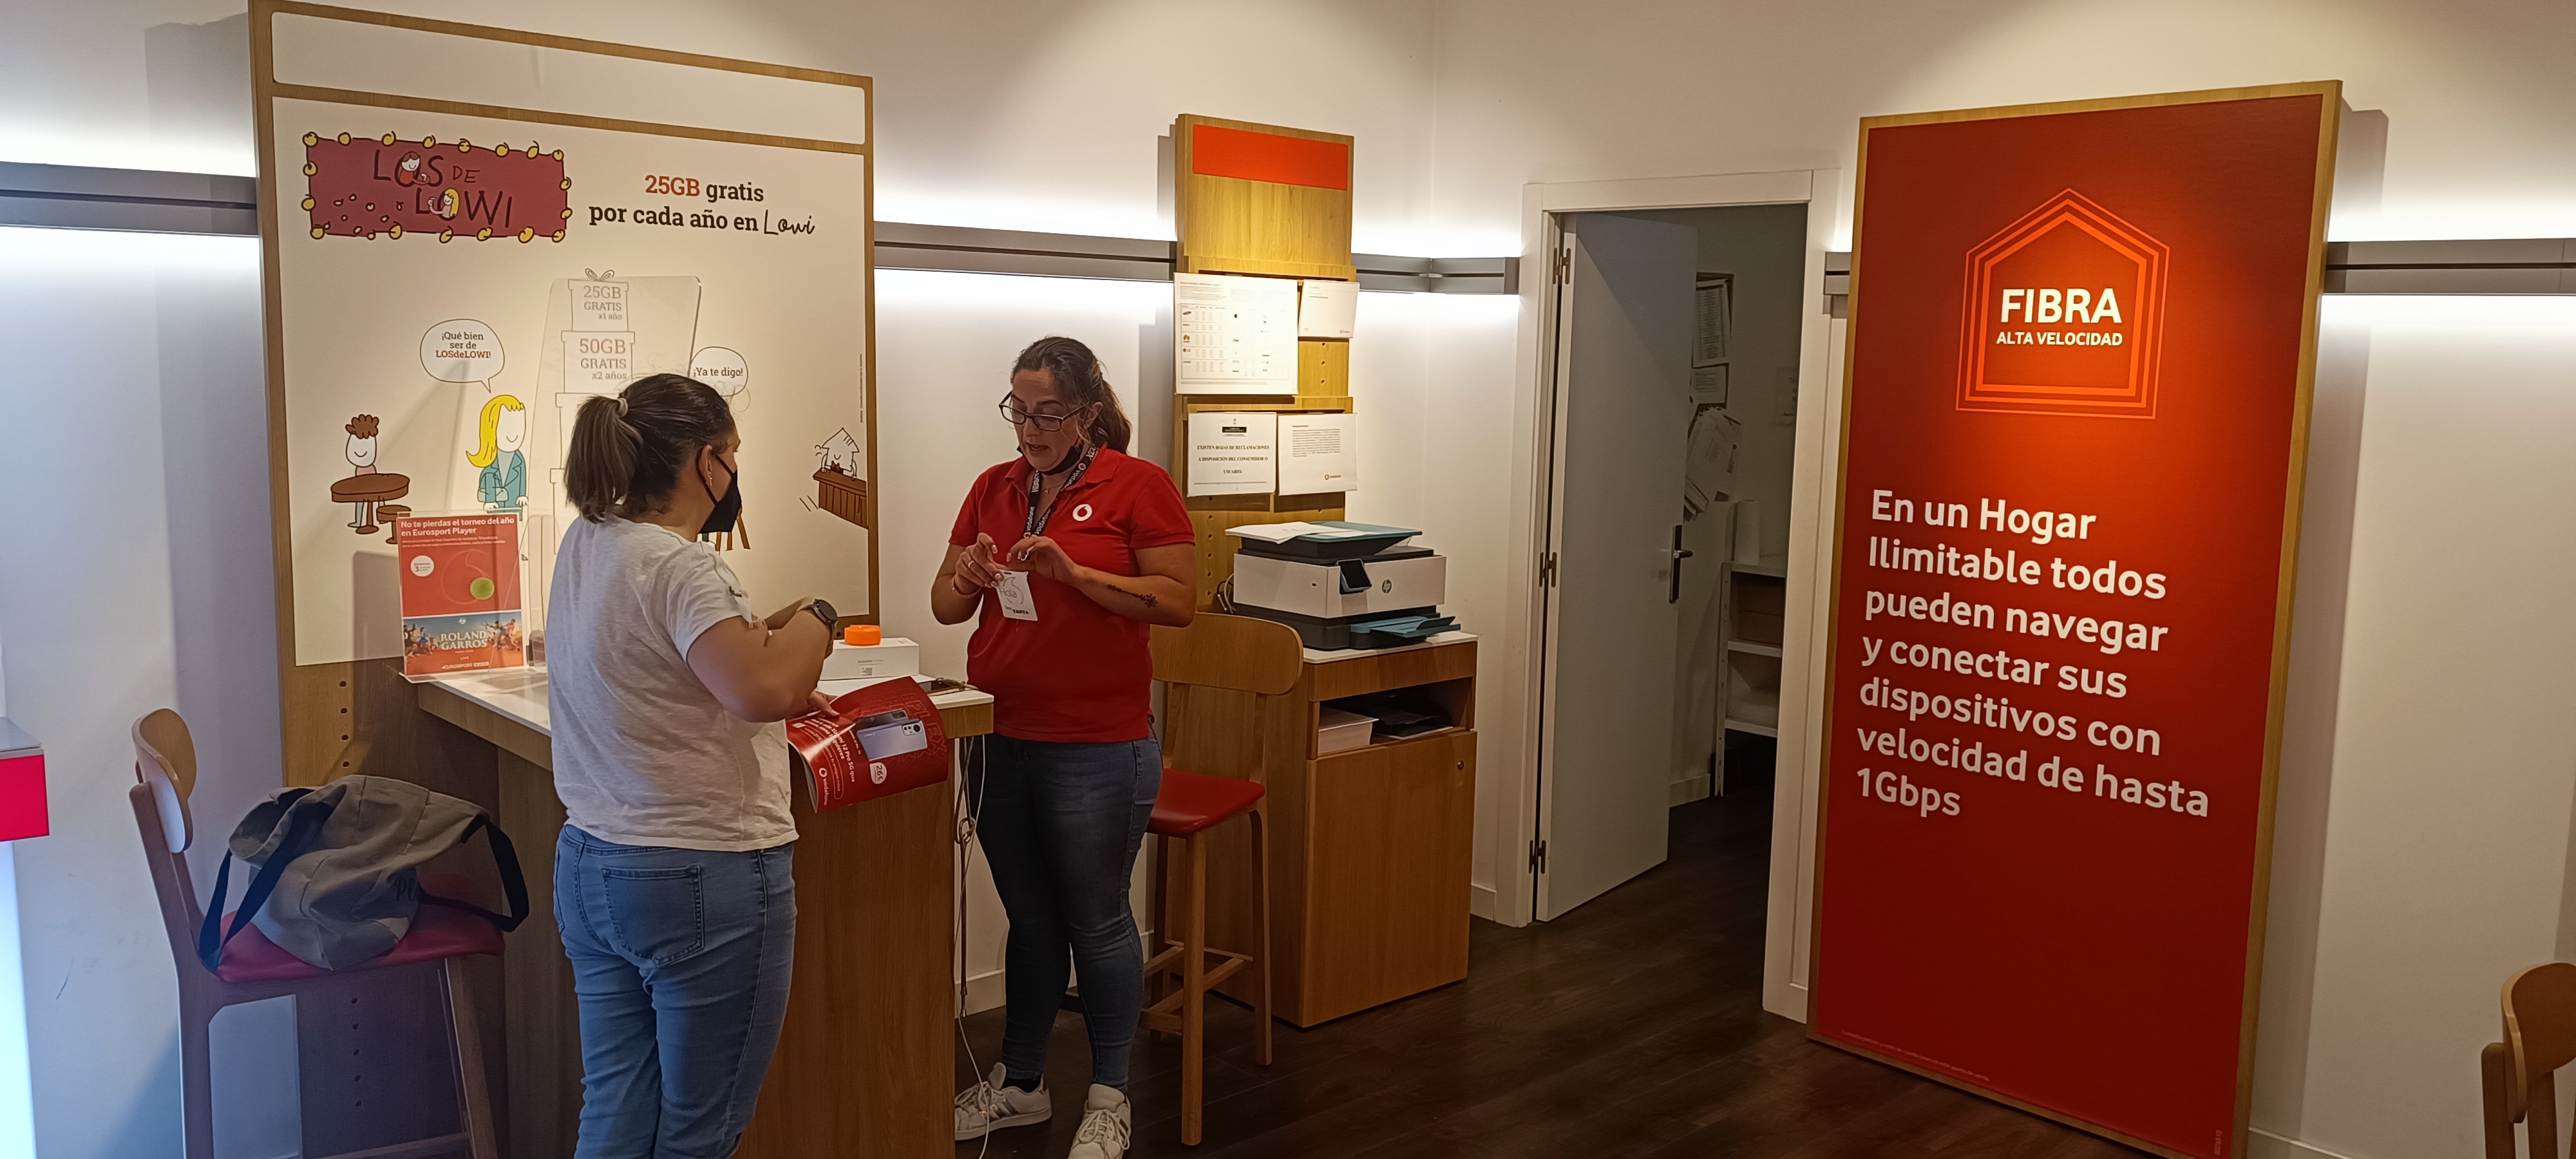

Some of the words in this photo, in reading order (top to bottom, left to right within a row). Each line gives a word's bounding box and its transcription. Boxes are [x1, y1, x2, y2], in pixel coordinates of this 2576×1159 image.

[374, 149, 444, 187] LOS
[452, 165, 480, 183] DE
[645, 174, 701, 197] 25GB
[706, 182, 764, 203] gratis
[415, 187, 513, 228] LOWI
[589, 205, 627, 225] por
[632, 206, 685, 227] cada
[690, 209, 728, 229] año
[734, 216, 759, 231] en
[763, 209, 815, 236] Lowi
[583, 285, 621, 299] 25GB
[583, 302, 622, 312] GRATIS
[2001, 288, 2122, 324] FIBRA
[441, 332, 462, 341] ¡Qué
[464, 332, 484, 341] bien
[1996, 331, 2034, 345] ALTA
[2036, 332, 2123, 346] VELOCIDAD
[466, 341, 477, 349] de
[580, 338, 626, 355] 50GB
[435, 350, 491, 359] LOSdeLOWI!
[580, 358, 627, 369] GRATIS
[592, 372, 603, 380] x2
[605, 372, 627, 380] años
[693, 367, 708, 377] ¡Ya
[721, 367, 744, 378] digo!
[422, 520, 451, 529] pierdas
[500, 516, 515, 525] año
[1872, 489, 1915, 523] En
[1924, 502, 1969, 528] un
[1980, 498, 2097, 545] Hogar
[413, 527, 451, 537] Eurosport
[452, 527, 477, 536] Player
[1870, 536, 2041, 585] Ilimitable
[2050, 558, 2166, 599] todos
[999, 588, 1017, 598] Hola
[1382, 579, 1392, 594] hp
[1865, 590, 1996, 629] pueden
[2005, 607, 2168, 655] navegar
[440, 631, 487, 641] ROLAND
[441, 639, 488, 650] GARROS
[1861, 636, 1883, 666] y
[1890, 640, 2050, 685] conectar
[2058, 664, 2127, 698] sus
[1860, 677, 2077, 741] dispositivos
[2087, 719, 2161, 756] con
[843, 751, 851, 762] Pro
[848, 762, 855, 771] 5G
[1857, 728, 2027, 782] velocidad
[2038, 756, 2084, 793] de
[2095, 764, 2209, 817] hasta
[1857, 768, 1961, 818] 1Gbps
